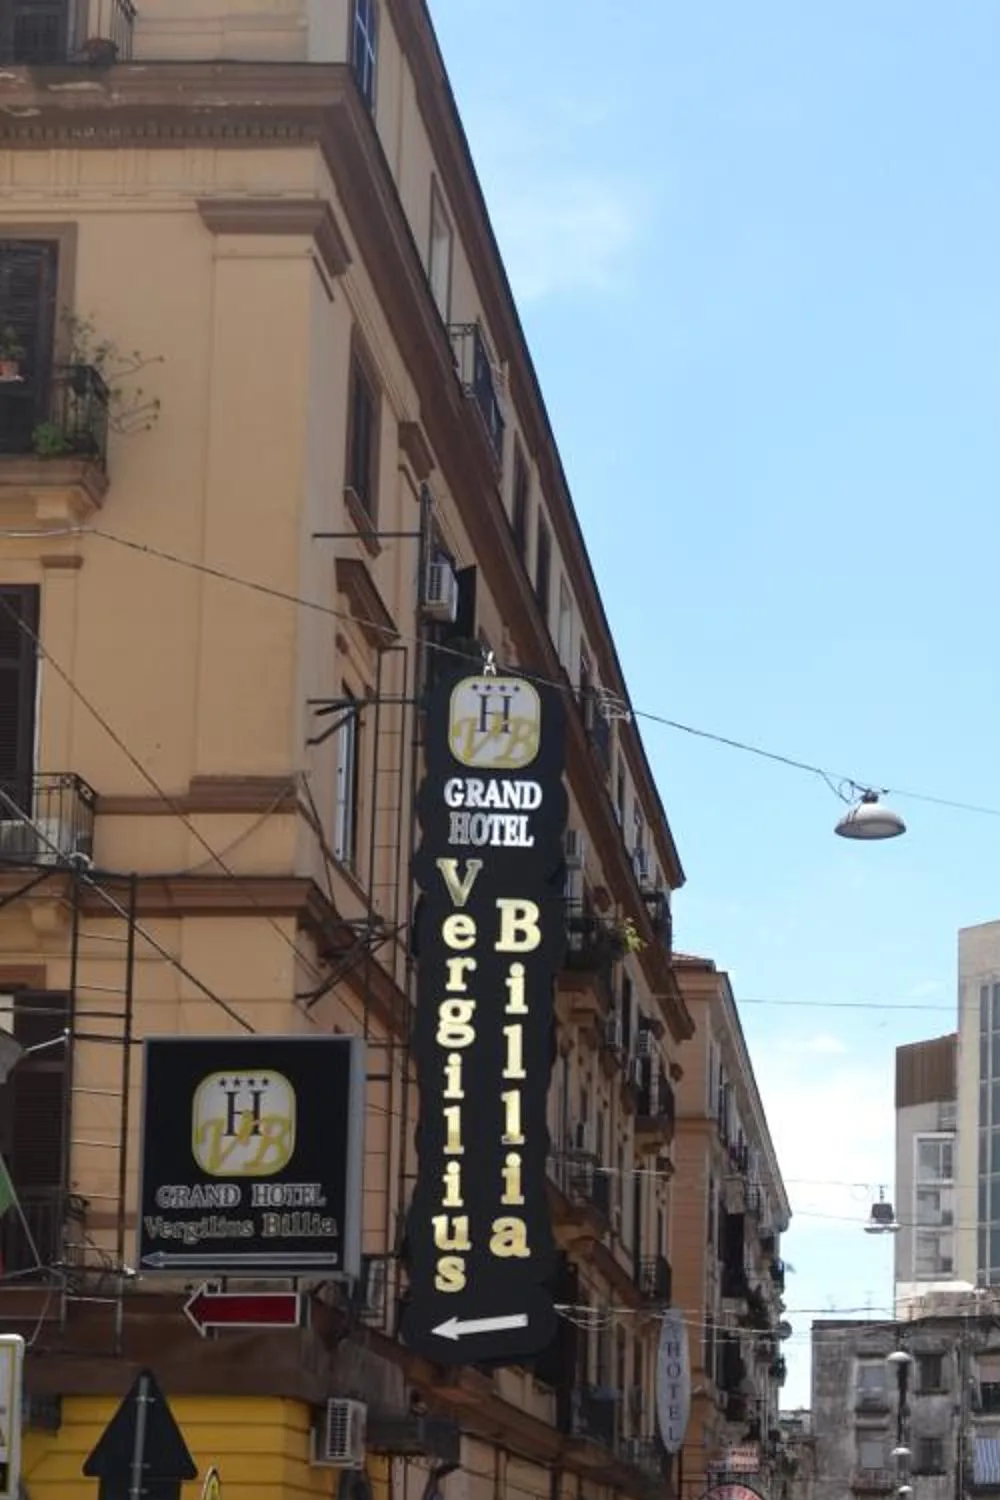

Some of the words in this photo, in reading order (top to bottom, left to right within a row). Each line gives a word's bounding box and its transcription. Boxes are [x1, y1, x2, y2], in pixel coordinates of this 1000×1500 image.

[443, 777, 544, 810] GRAND
[447, 811, 536, 848] HOTEL
[431, 857, 483, 1293] Vergilius
[488, 897, 543, 1259] Billia
[156, 1183, 242, 1209] GRAND
[251, 1182, 327, 1207] HOTEL
[143, 1215, 256, 1244] Vergilius
[262, 1211, 338, 1238] Billia
[664, 1341, 682, 1441] HOTEL
